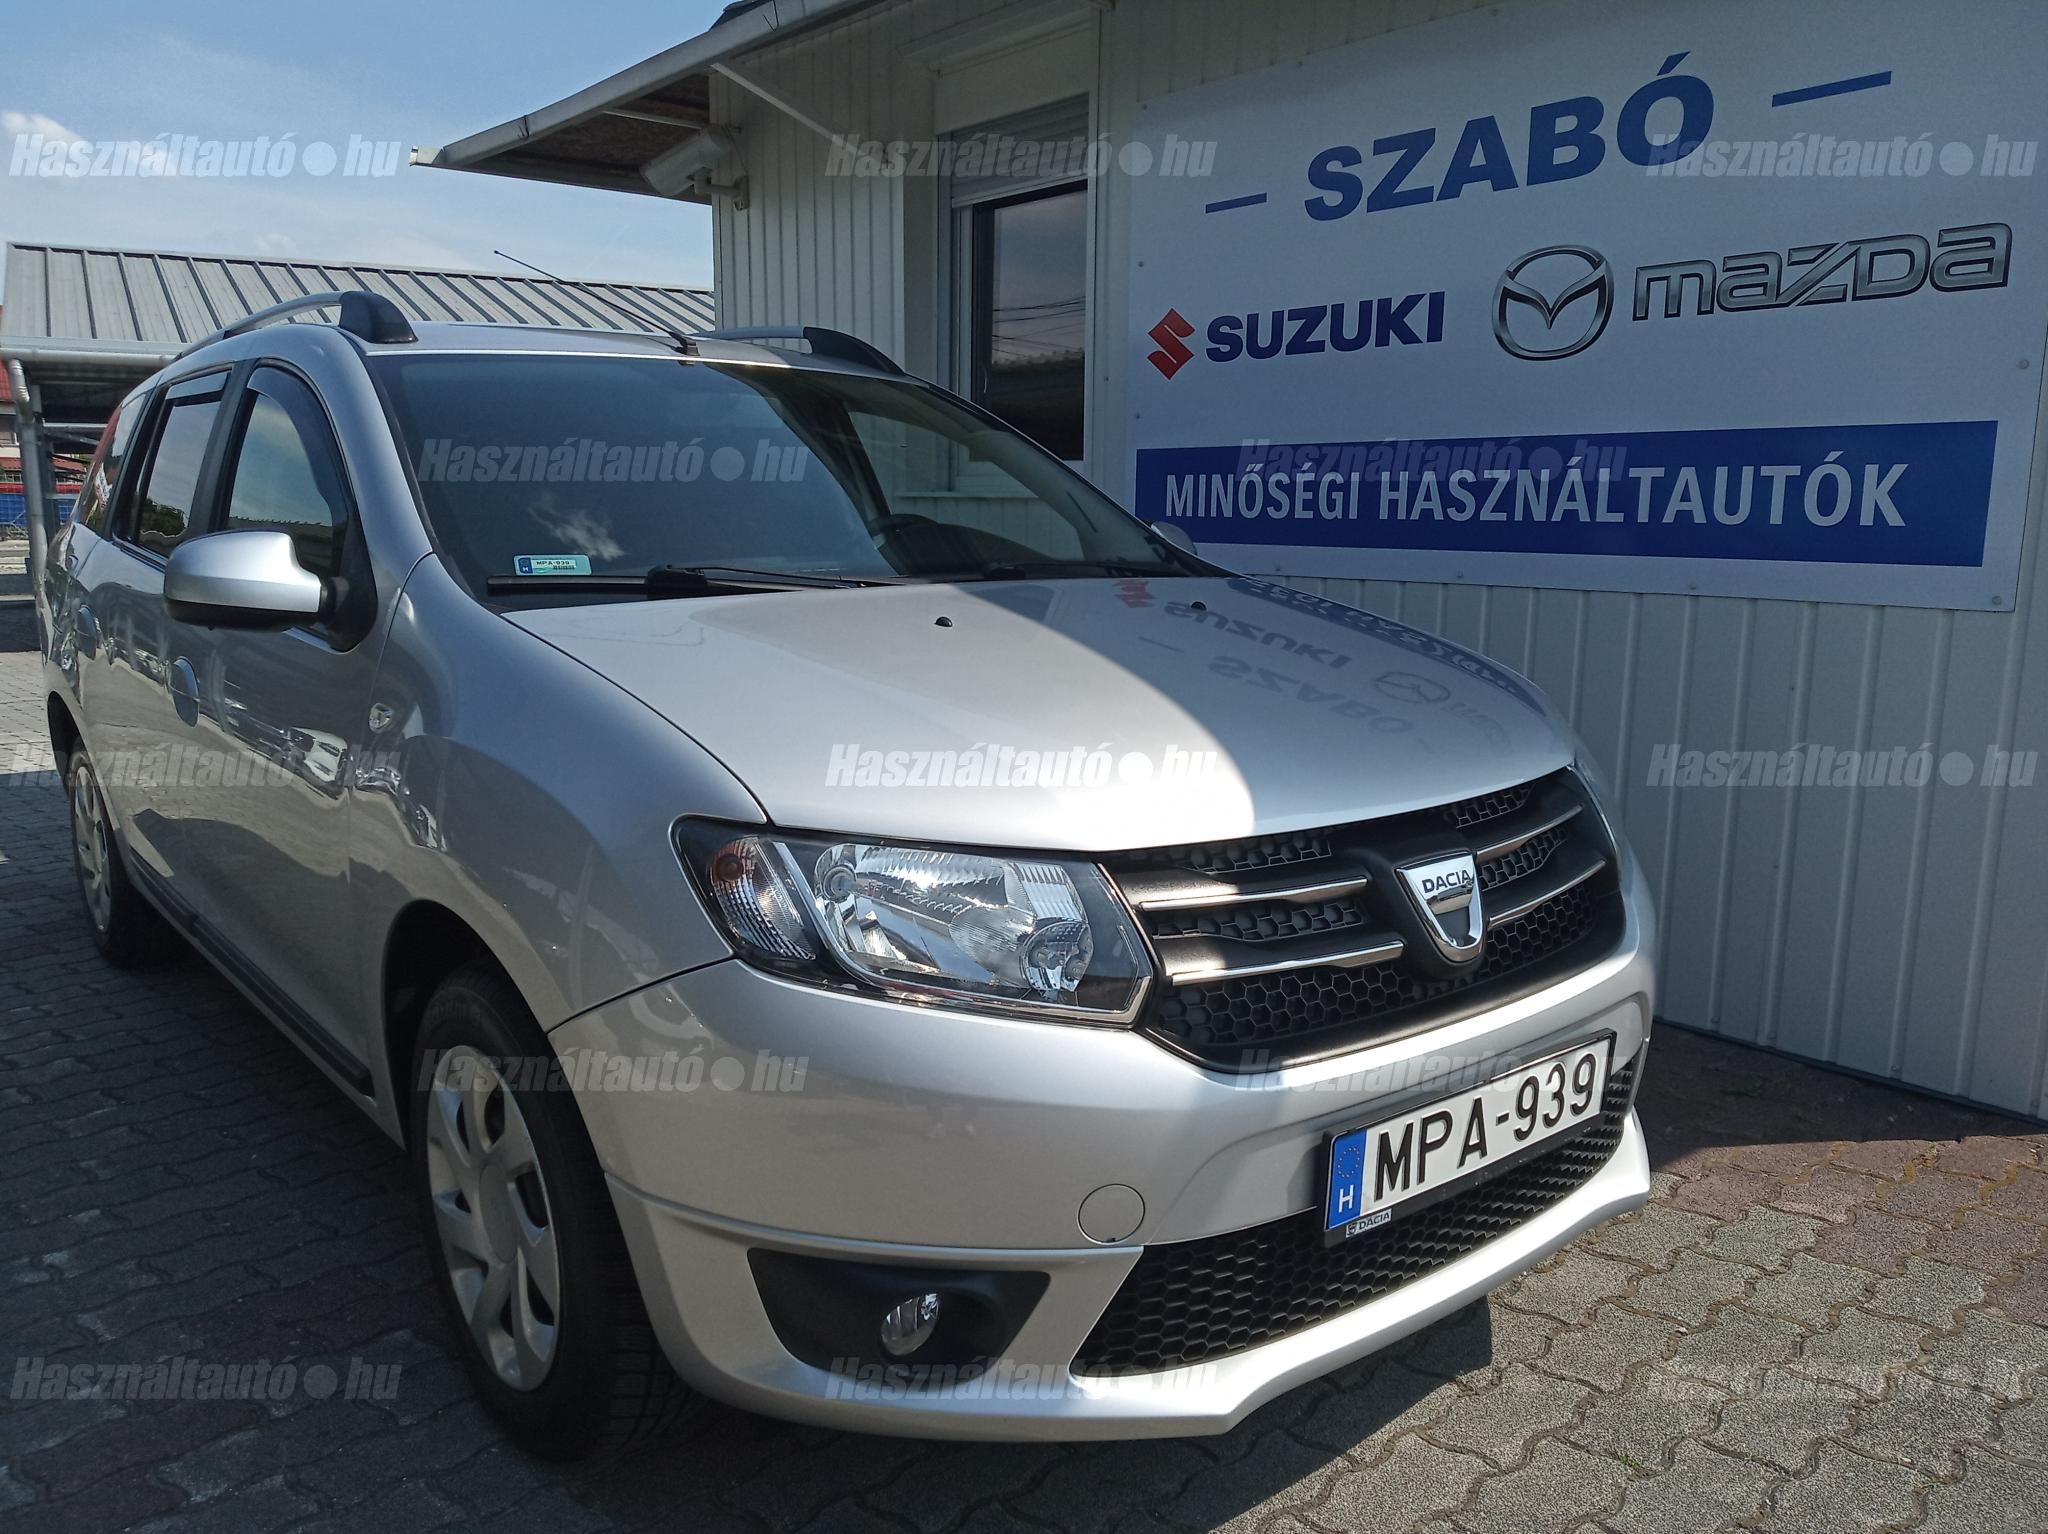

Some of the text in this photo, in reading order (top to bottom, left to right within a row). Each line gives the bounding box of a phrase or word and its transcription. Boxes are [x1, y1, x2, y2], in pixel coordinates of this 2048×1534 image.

[1303, 51, 1715, 222] SZABÓ
[1205, 291, 1446, 363] SUZUKI
[1165, 450, 1908, 528] MINŐSÉGI HASZNÁLTAUTÓK
[1421, 869, 1472, 893] DACIA
[1373, 1052, 1598, 1203] MPA-939
[1338, 1184, 1354, 1213] H
[1359, 1212, 1390, 1230] DACIA
